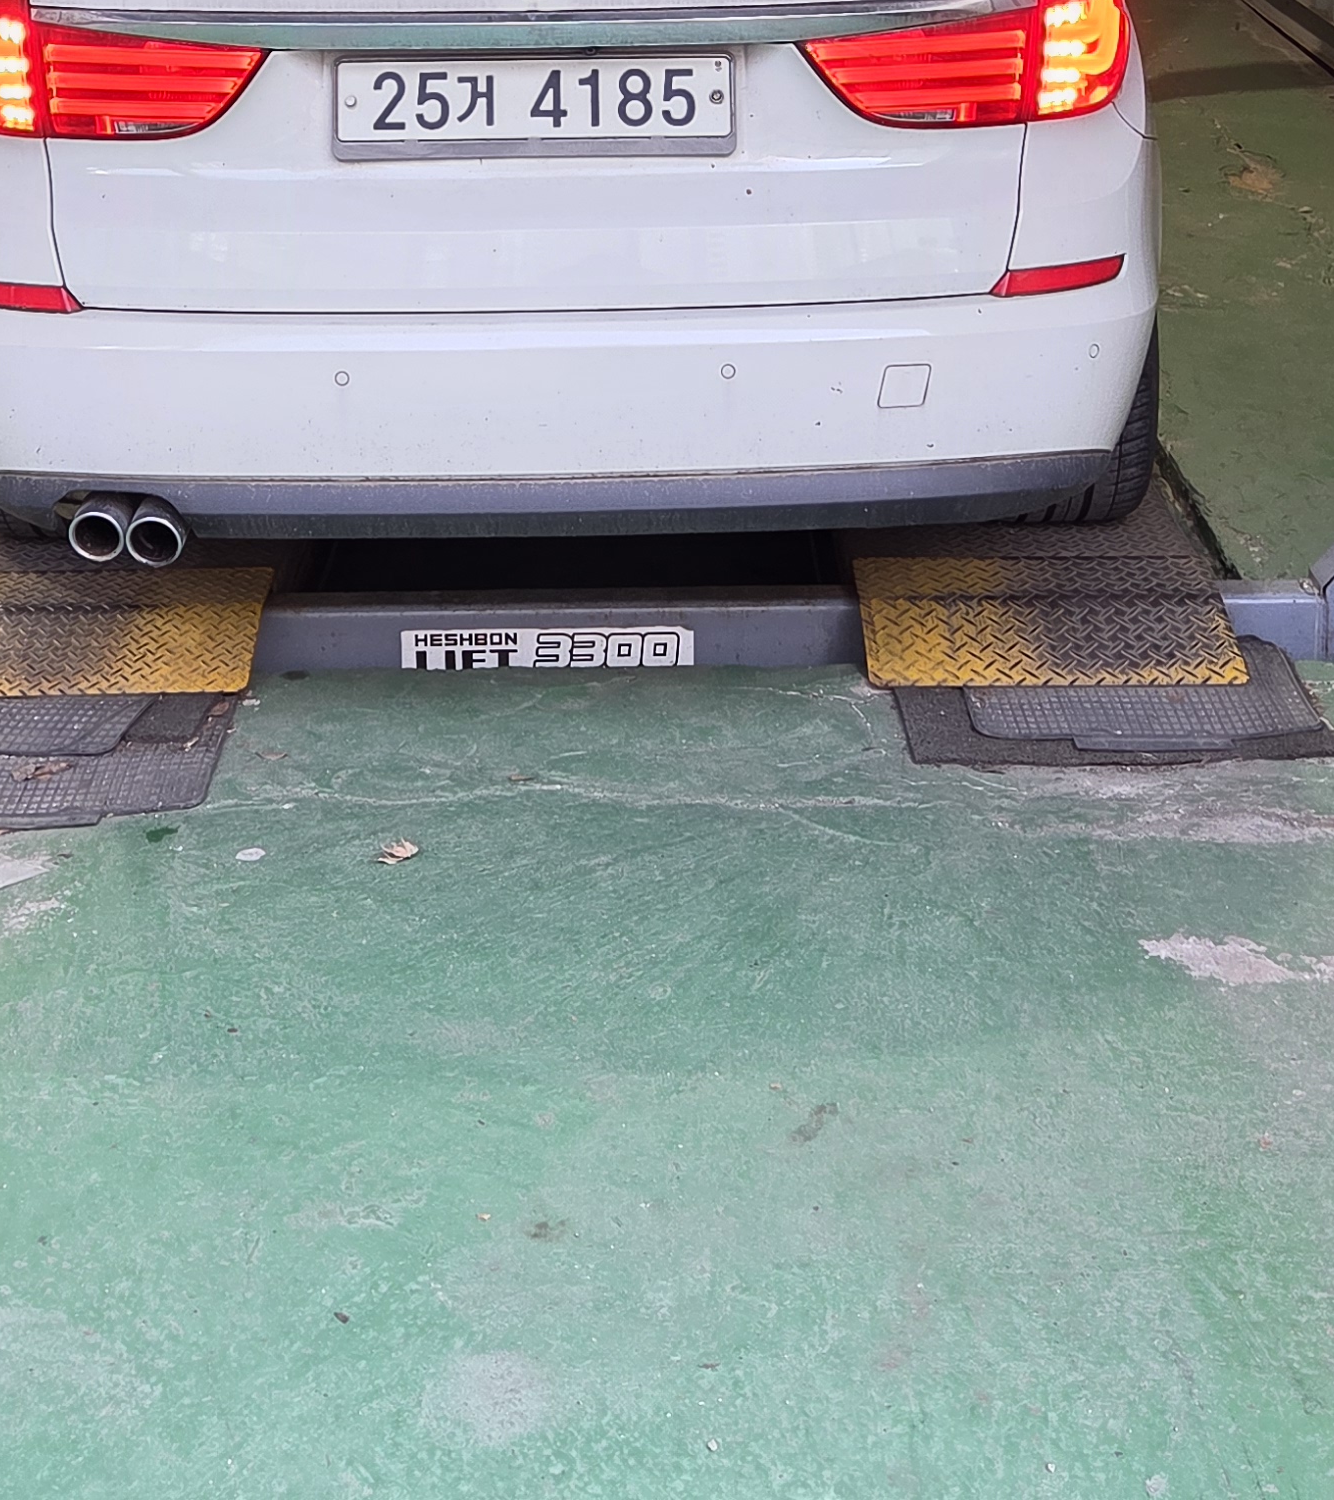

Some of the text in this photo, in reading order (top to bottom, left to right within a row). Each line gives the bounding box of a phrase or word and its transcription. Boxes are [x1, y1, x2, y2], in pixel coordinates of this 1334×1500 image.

[372, 68, 696, 131] 25거 4185
[414, 632, 518, 647] HESHBON
[532, 632, 680, 668] 3300
